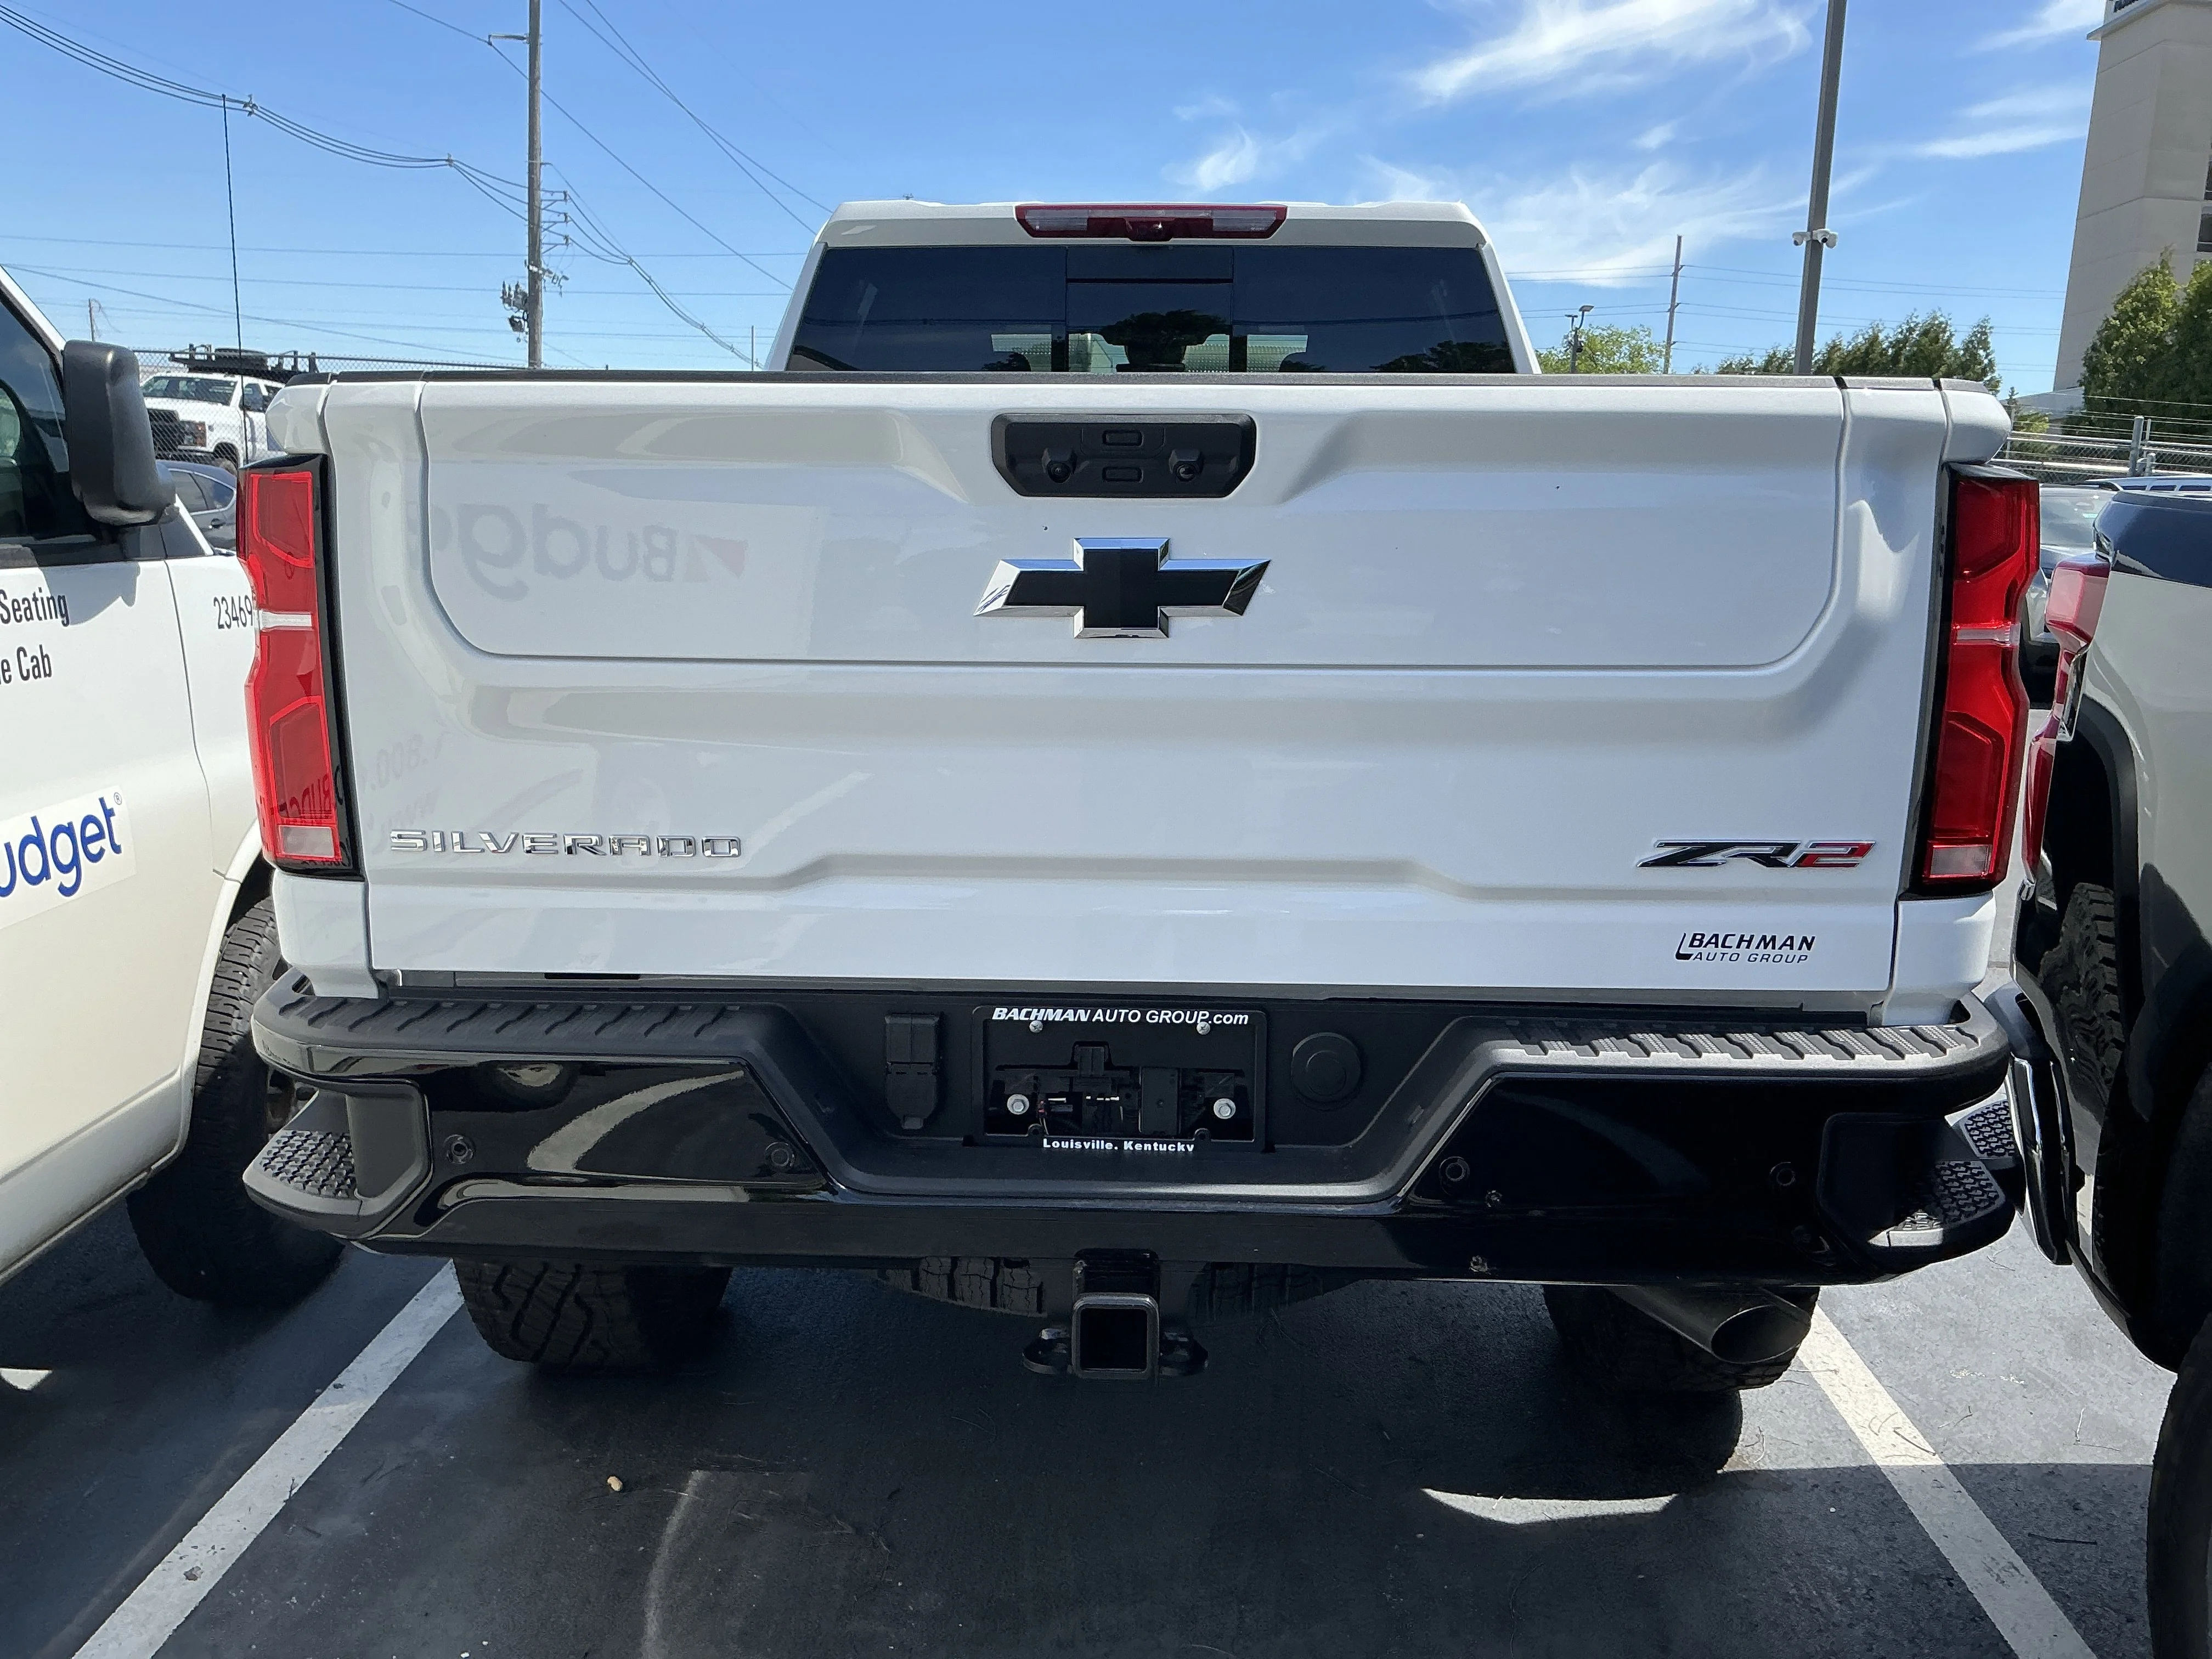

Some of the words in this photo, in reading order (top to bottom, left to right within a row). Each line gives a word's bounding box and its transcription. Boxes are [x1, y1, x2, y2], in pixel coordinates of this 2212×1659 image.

[0, 586, 70, 627] Seating
[213, 595, 253, 629] 23469
[16, 644, 52, 681] Cab
[390, 829, 741, 858] SILVERADO
[1637, 839, 1876, 868] ZR2
[1688, 933, 1816, 951] BACHMAN
[1692, 951, 1740, 962] AUTO
[1747, 953, 1808, 964] GROUP
[992, 1007, 1091, 1022] BACHMAN
[1092, 1009, 1142, 1023] AUTO
